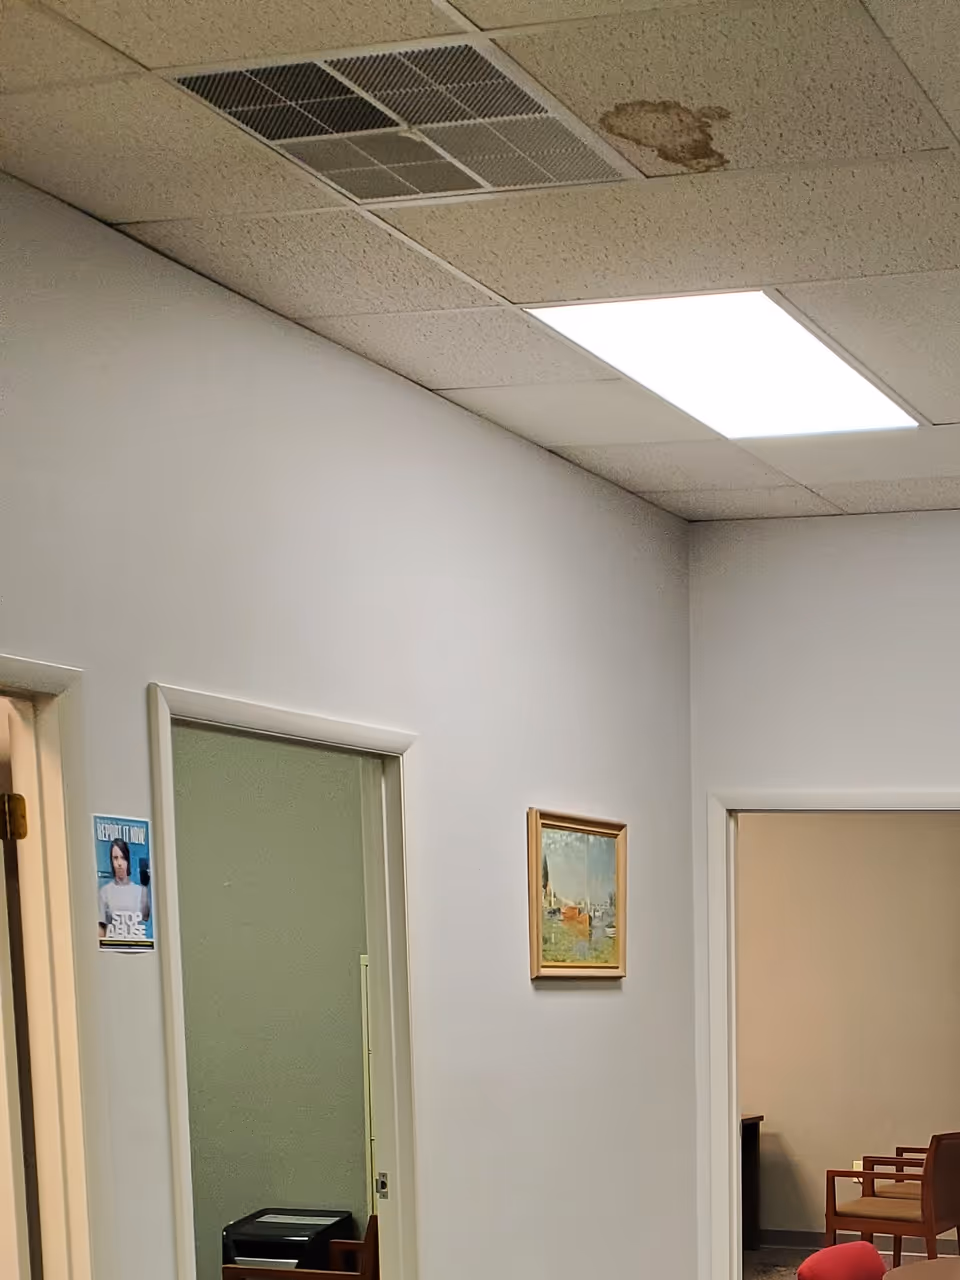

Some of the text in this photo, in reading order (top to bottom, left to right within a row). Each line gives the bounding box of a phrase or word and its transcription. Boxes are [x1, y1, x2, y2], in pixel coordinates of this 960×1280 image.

[96, 823, 122, 842] REPORT
[123, 825, 130, 843] IT
[111, 911, 143, 926] STOP
[106, 923, 146, 939] ABUSE
